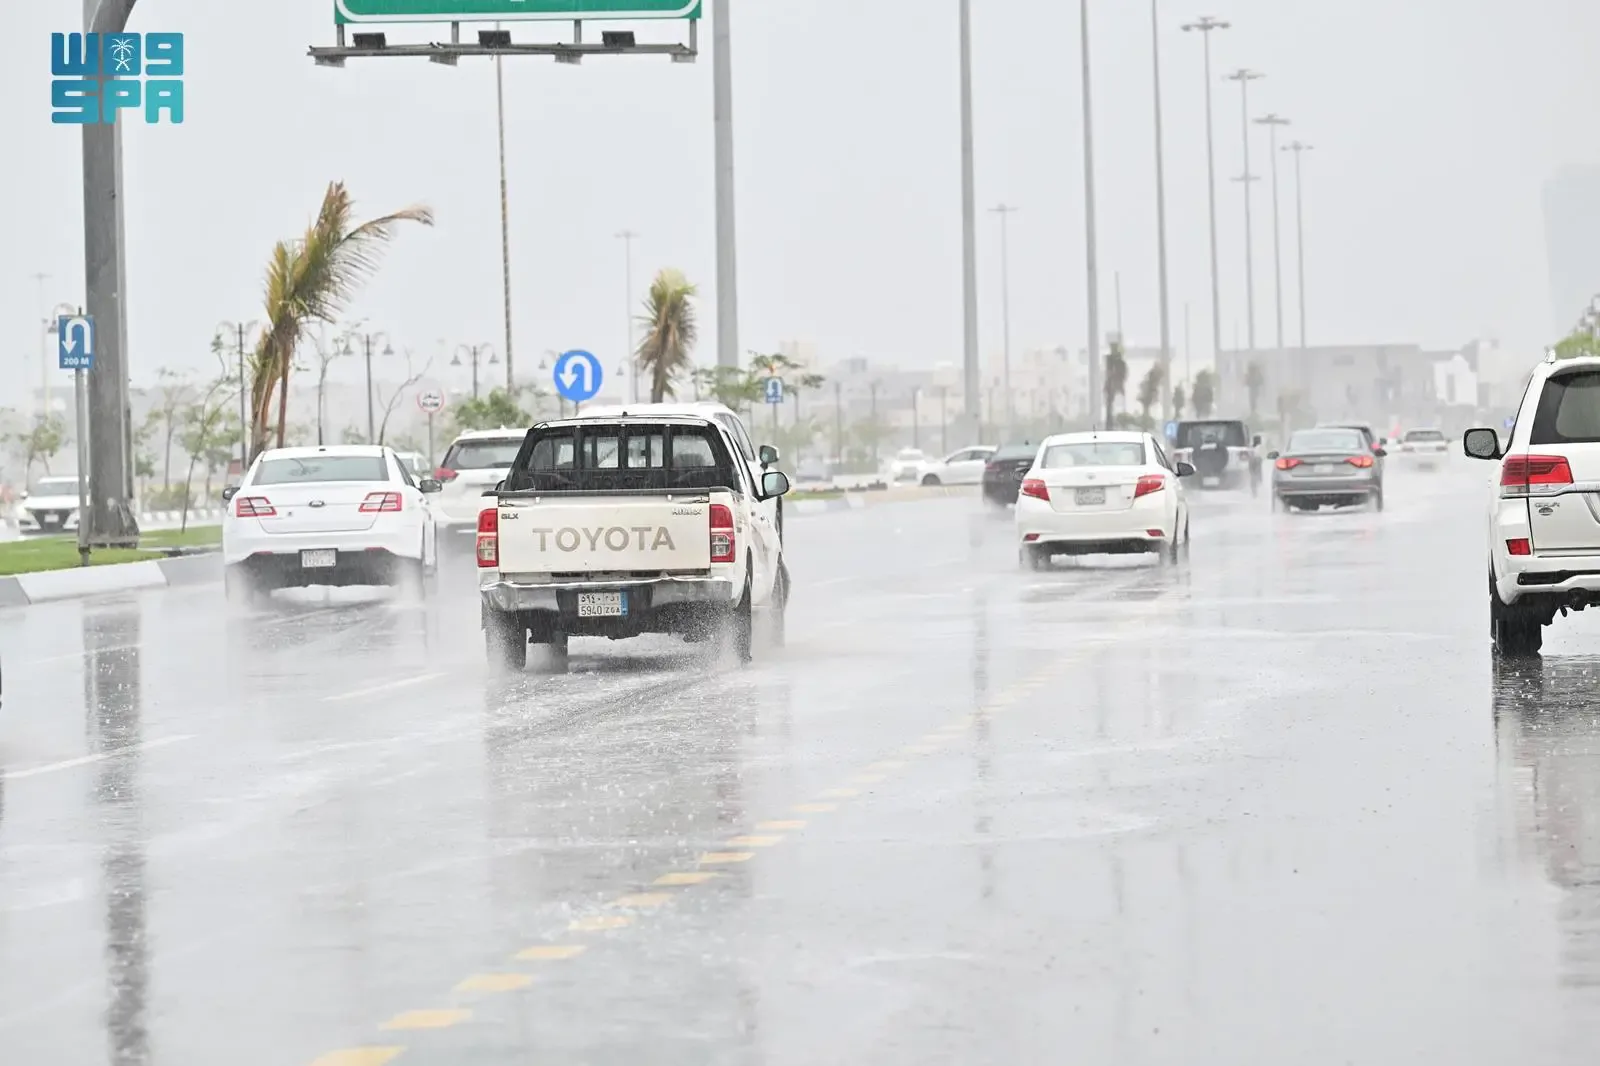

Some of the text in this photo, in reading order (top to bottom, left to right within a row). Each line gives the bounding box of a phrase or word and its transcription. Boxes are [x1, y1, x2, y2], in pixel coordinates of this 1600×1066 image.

[64, 357, 79, 365] 200
[532, 527, 676, 552] TOYOTA
[581, 605, 602, 615] 5940
